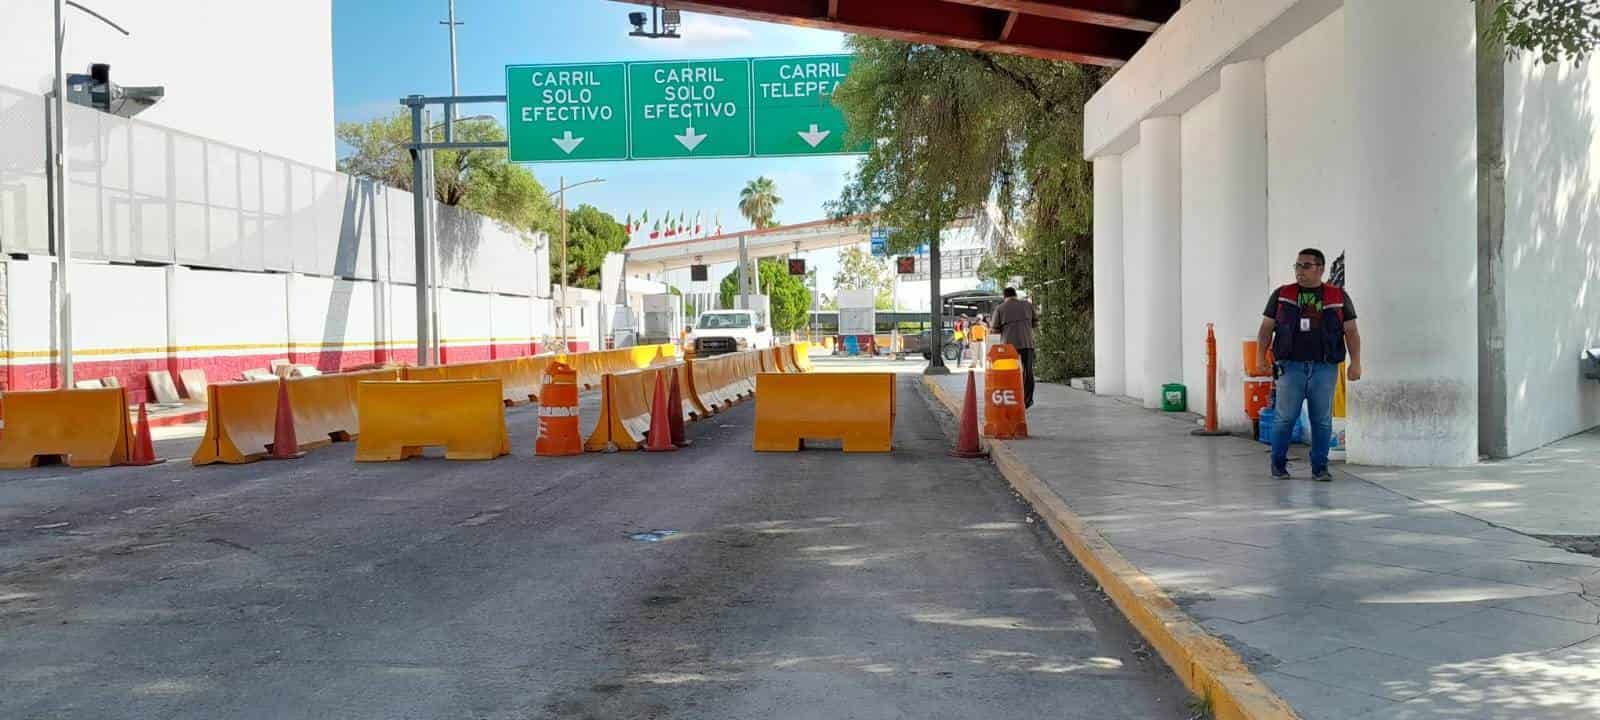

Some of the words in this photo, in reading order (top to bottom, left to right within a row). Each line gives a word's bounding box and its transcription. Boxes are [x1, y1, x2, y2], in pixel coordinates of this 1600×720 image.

[532, 71, 600, 87] CARRIL
[654, 67, 724, 84] CARRIL
[780, 62, 846, 80] CARRIL
[542, 88, 592, 104] SOLO
[664, 85, 716, 101] SOLO
[522, 105, 612, 122] EFECTIVO
[644, 102, 736, 119] EFECTIVO
